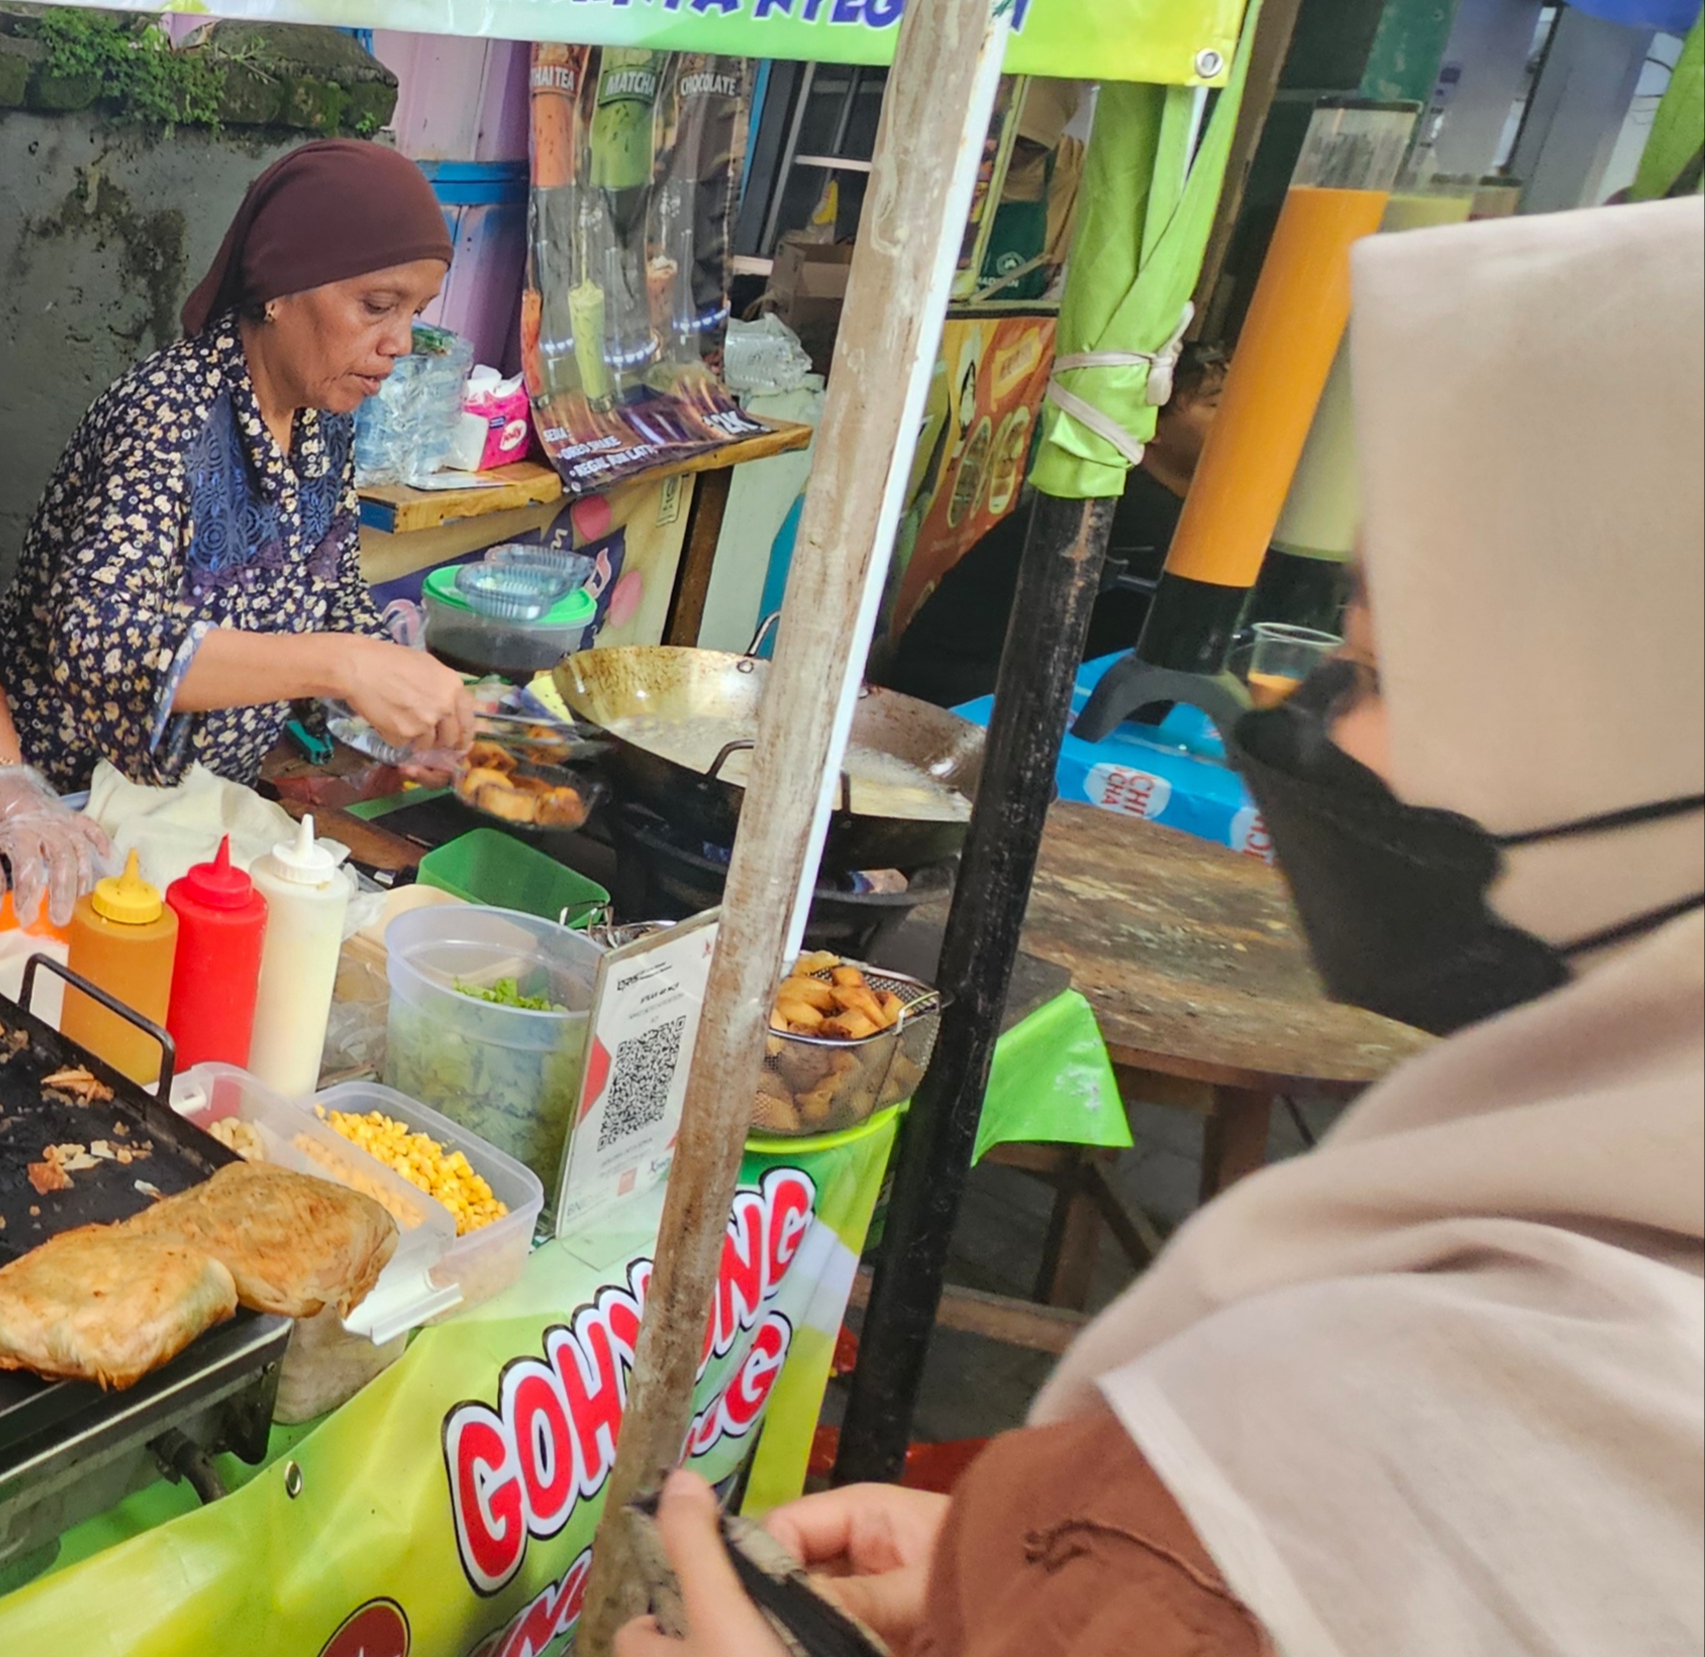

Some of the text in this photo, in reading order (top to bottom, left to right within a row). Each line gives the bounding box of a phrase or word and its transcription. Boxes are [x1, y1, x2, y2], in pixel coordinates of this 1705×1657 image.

[530, 66, 575, 92] HAI TEA
[605, 71, 657, 97] MATCHA
[680, 72, 737, 97] CHOCOLATE
